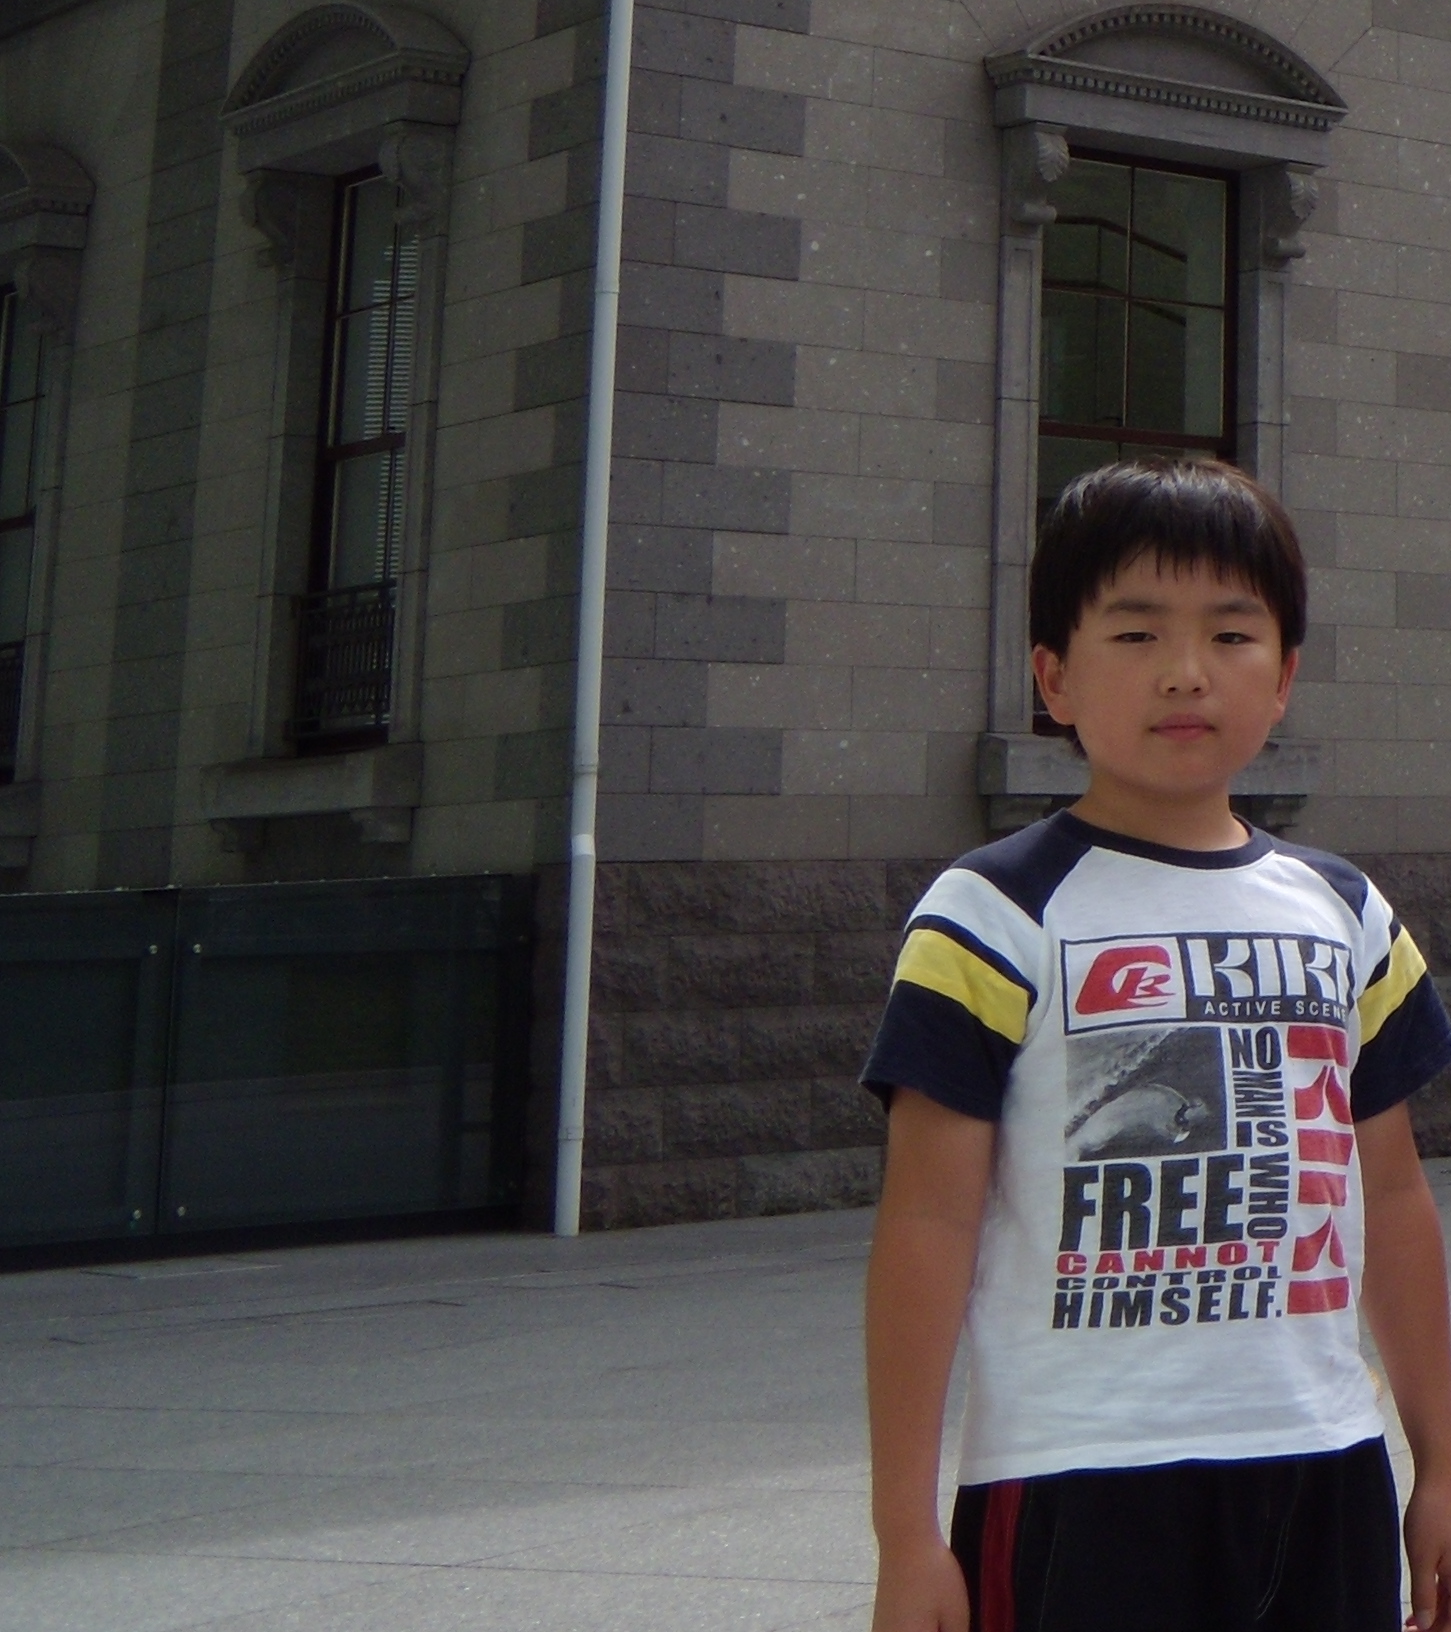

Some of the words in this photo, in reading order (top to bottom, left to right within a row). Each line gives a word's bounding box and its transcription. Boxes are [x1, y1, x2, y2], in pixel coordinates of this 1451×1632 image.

[1204, 1000, 1282, 1017] ACTIVE
[1228, 1026, 1282, 1070] NO
[1232, 1070, 1287, 1118] MAN
[1236, 1120, 1289, 1148] IS
[1058, 1153, 1245, 1251] FREE
[1247, 1152, 1290, 1240] WHO
[1056, 1241, 1281, 1275] CANNOT
[1056, 1265, 1283, 1290] CONTROL
[1052, 1282, 1282, 1329] HIMSELF.
